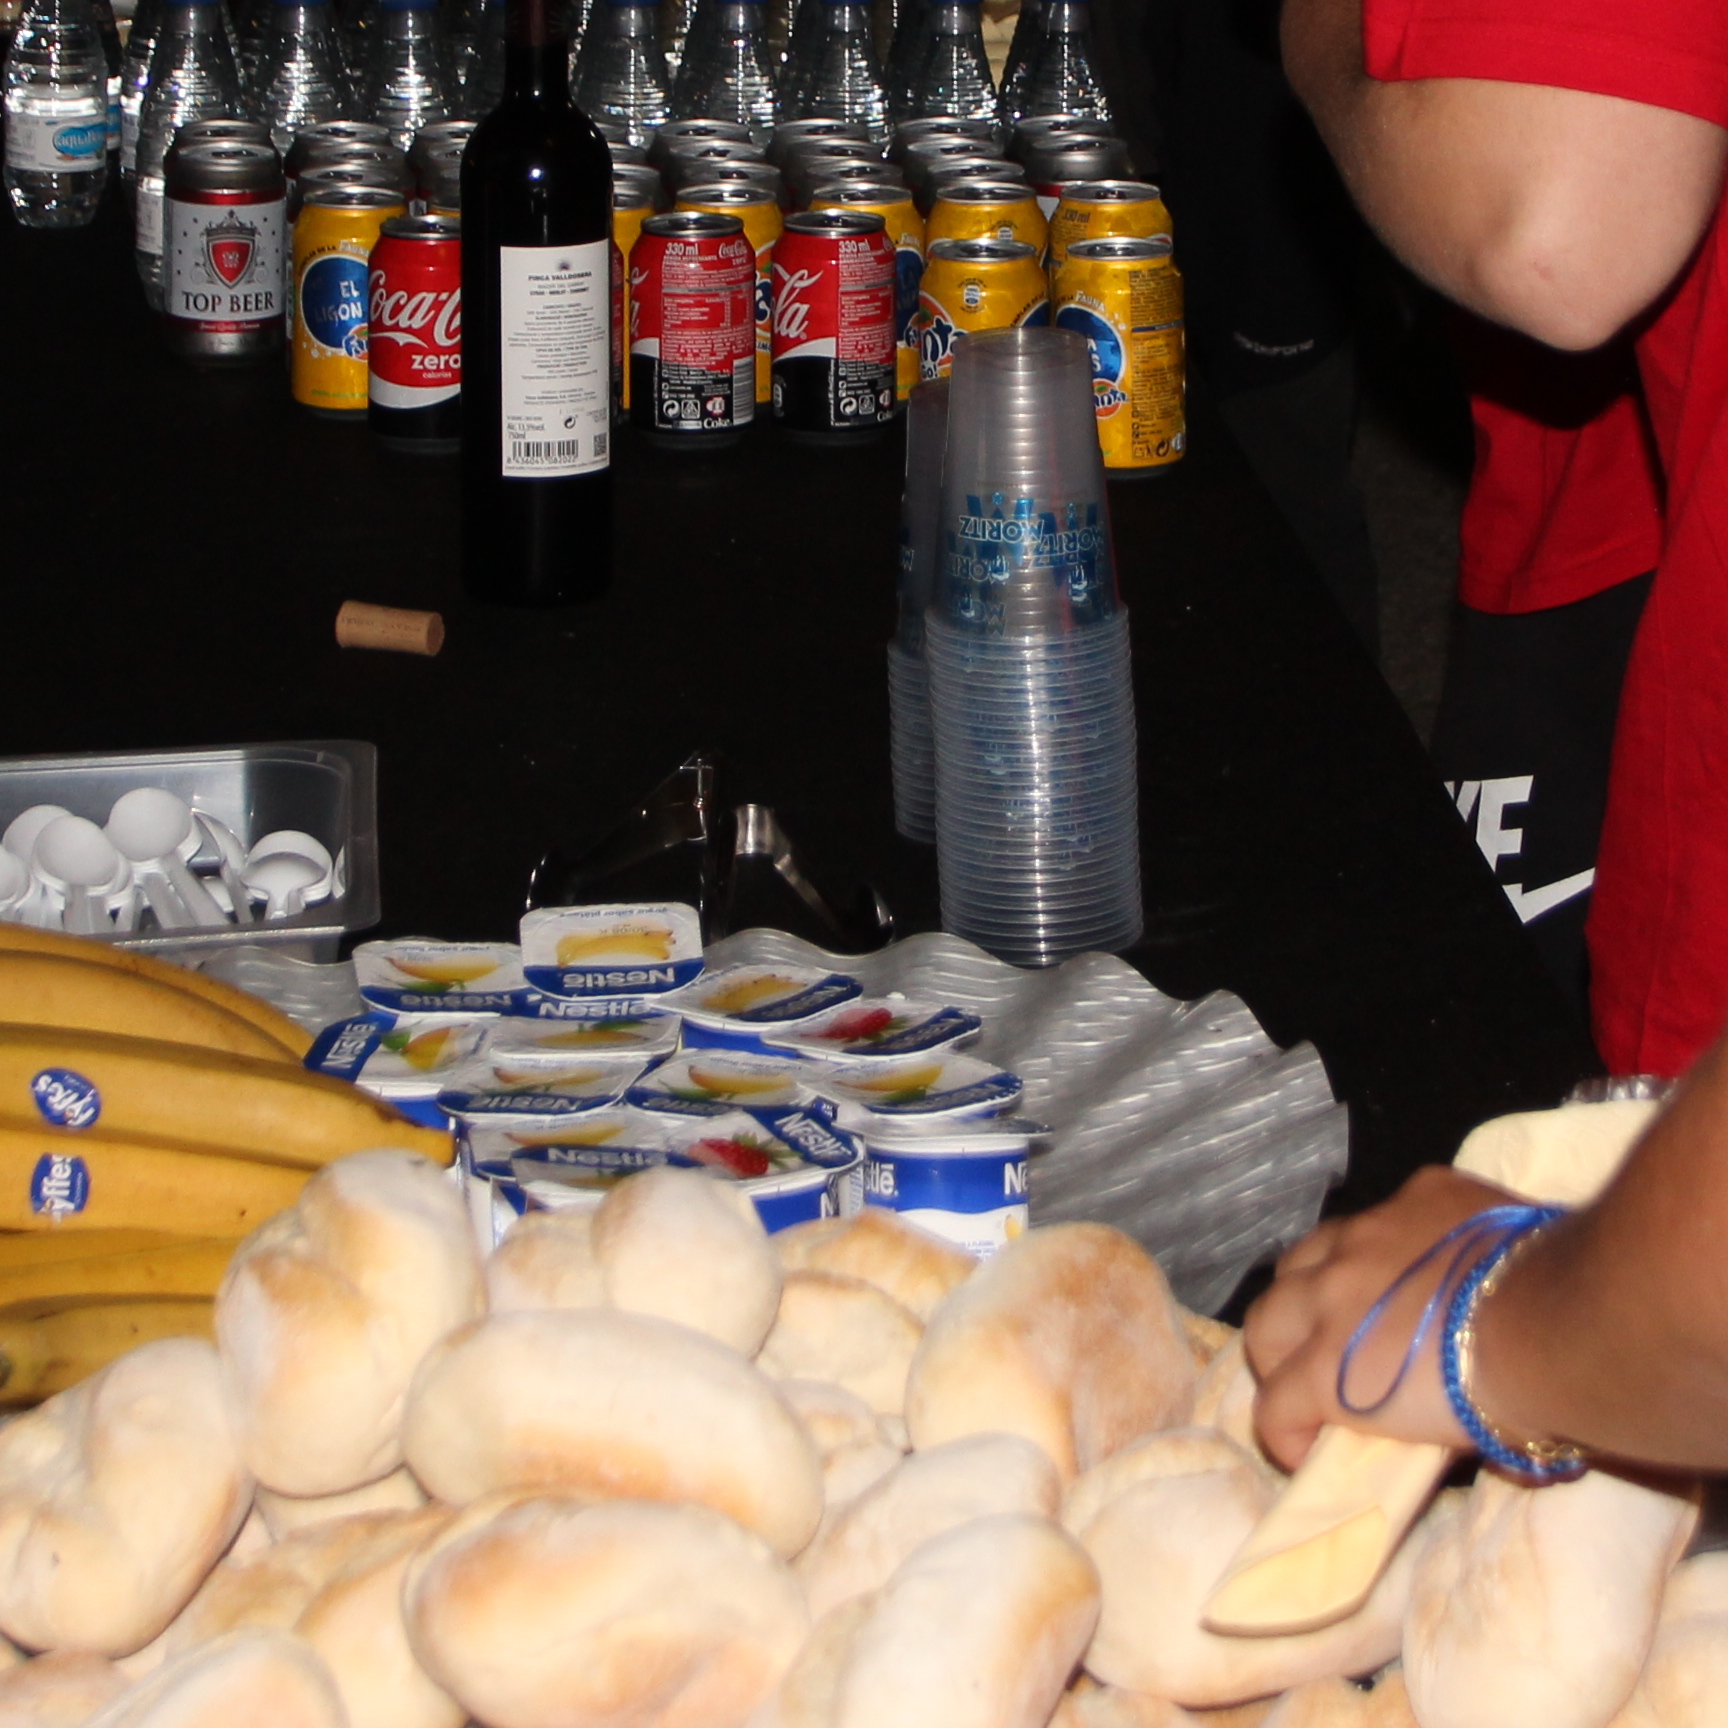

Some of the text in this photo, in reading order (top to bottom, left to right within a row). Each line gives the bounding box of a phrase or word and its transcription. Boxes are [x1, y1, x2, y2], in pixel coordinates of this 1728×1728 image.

[665, 242, 699, 255] 330 ml
[839, 239, 870, 253] 330 ml
[339, 280, 360, 298] EL
[182, 290, 274, 313] TOP BEER
[410, 353, 461, 370] zero
[958, 515, 1045, 544] MORITZ
[33, 1073, 97, 1127] Fyffes
